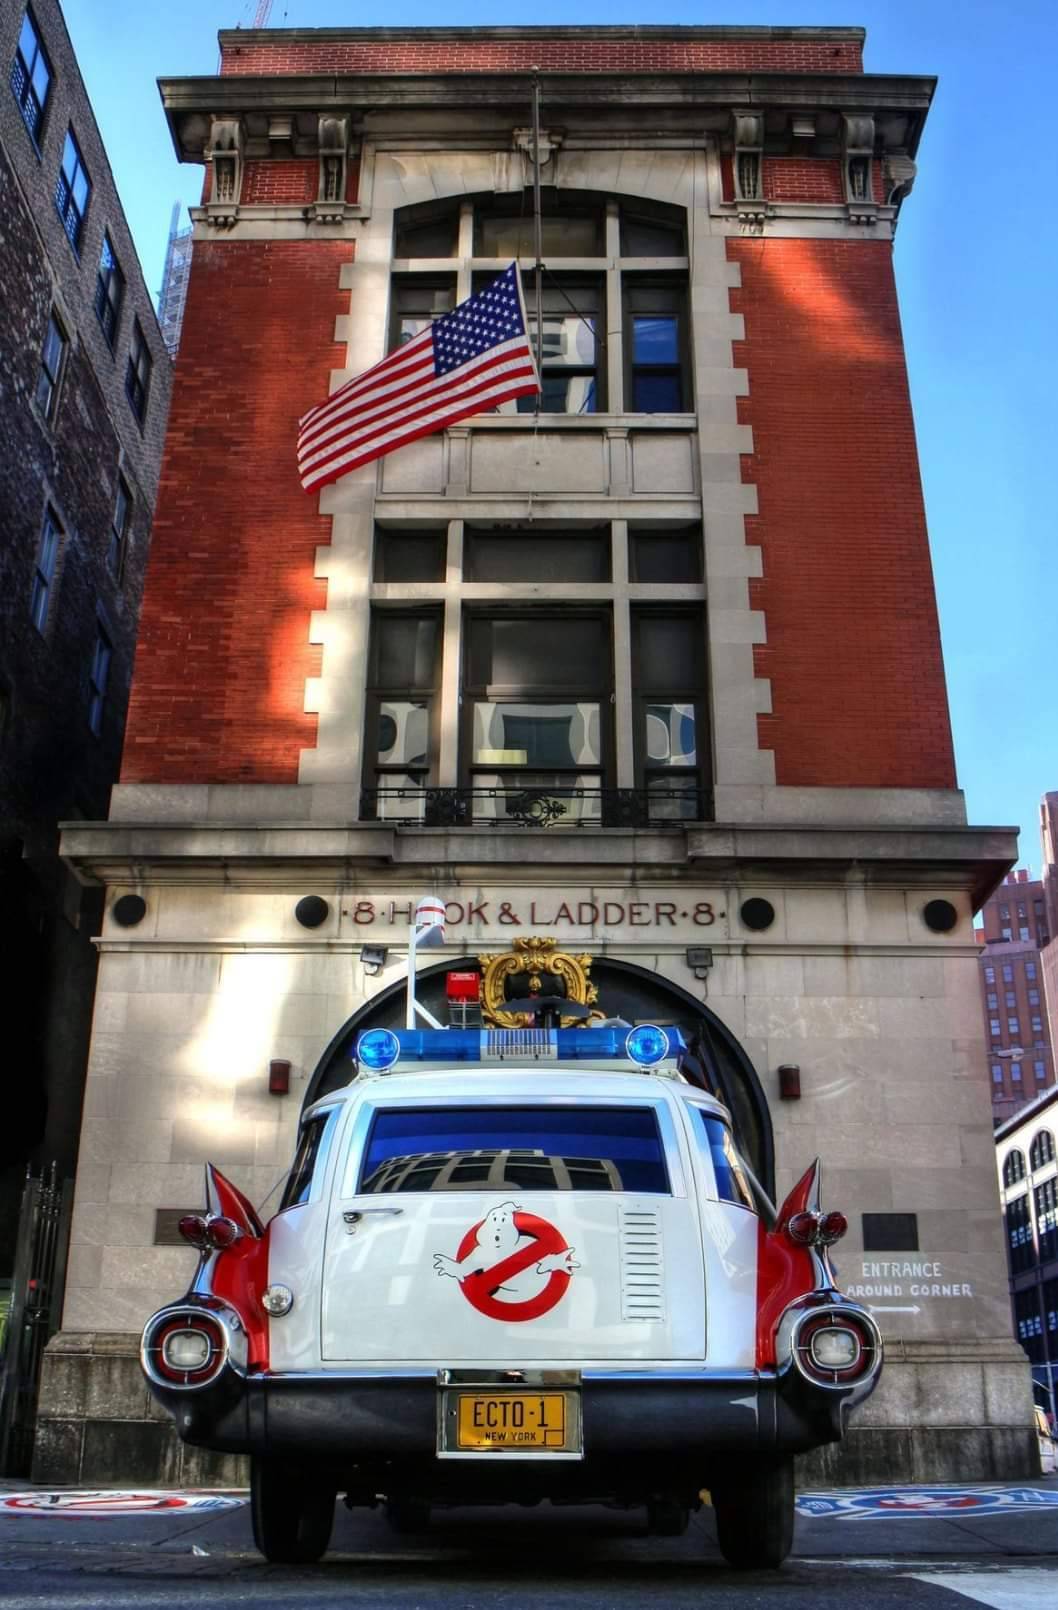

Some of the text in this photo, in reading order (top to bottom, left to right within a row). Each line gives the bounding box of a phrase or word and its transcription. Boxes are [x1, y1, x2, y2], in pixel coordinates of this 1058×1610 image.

[389, 901, 489, 925] HOK
[498, 901, 522, 926] &
[862, 1262, 942, 1278] ENTRANCE
[847, 1284, 902, 1297] AROUND
[485, 1431, 536, 1441] NEW YORK
